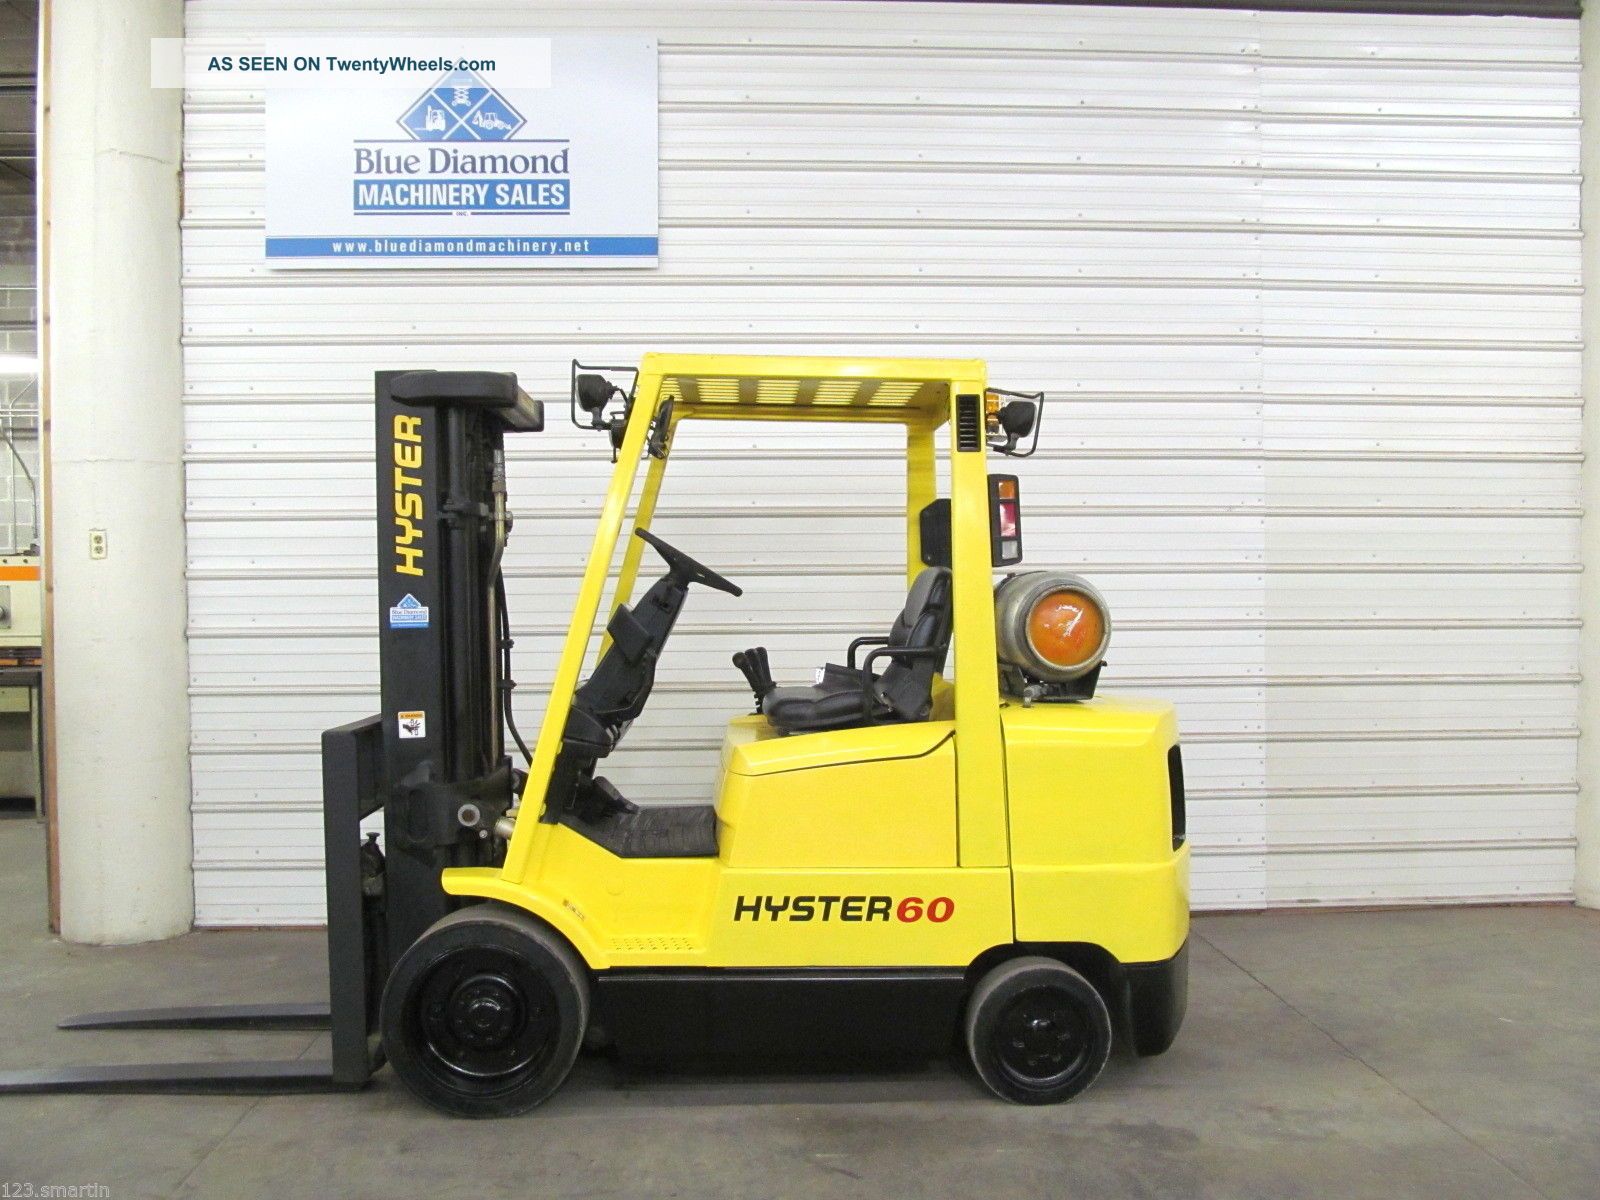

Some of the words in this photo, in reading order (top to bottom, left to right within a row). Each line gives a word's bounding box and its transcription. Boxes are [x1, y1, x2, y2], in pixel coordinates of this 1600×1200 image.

[354, 147, 421, 175] Blue
[428, 147, 570, 175] Diamond
[358, 183, 489, 206] MACHINERY
[495, 183, 565, 206] SALES
[332, 240, 590, 255] www.bluediamondmachinery.net
[393, 414, 424, 577] HYSTER
